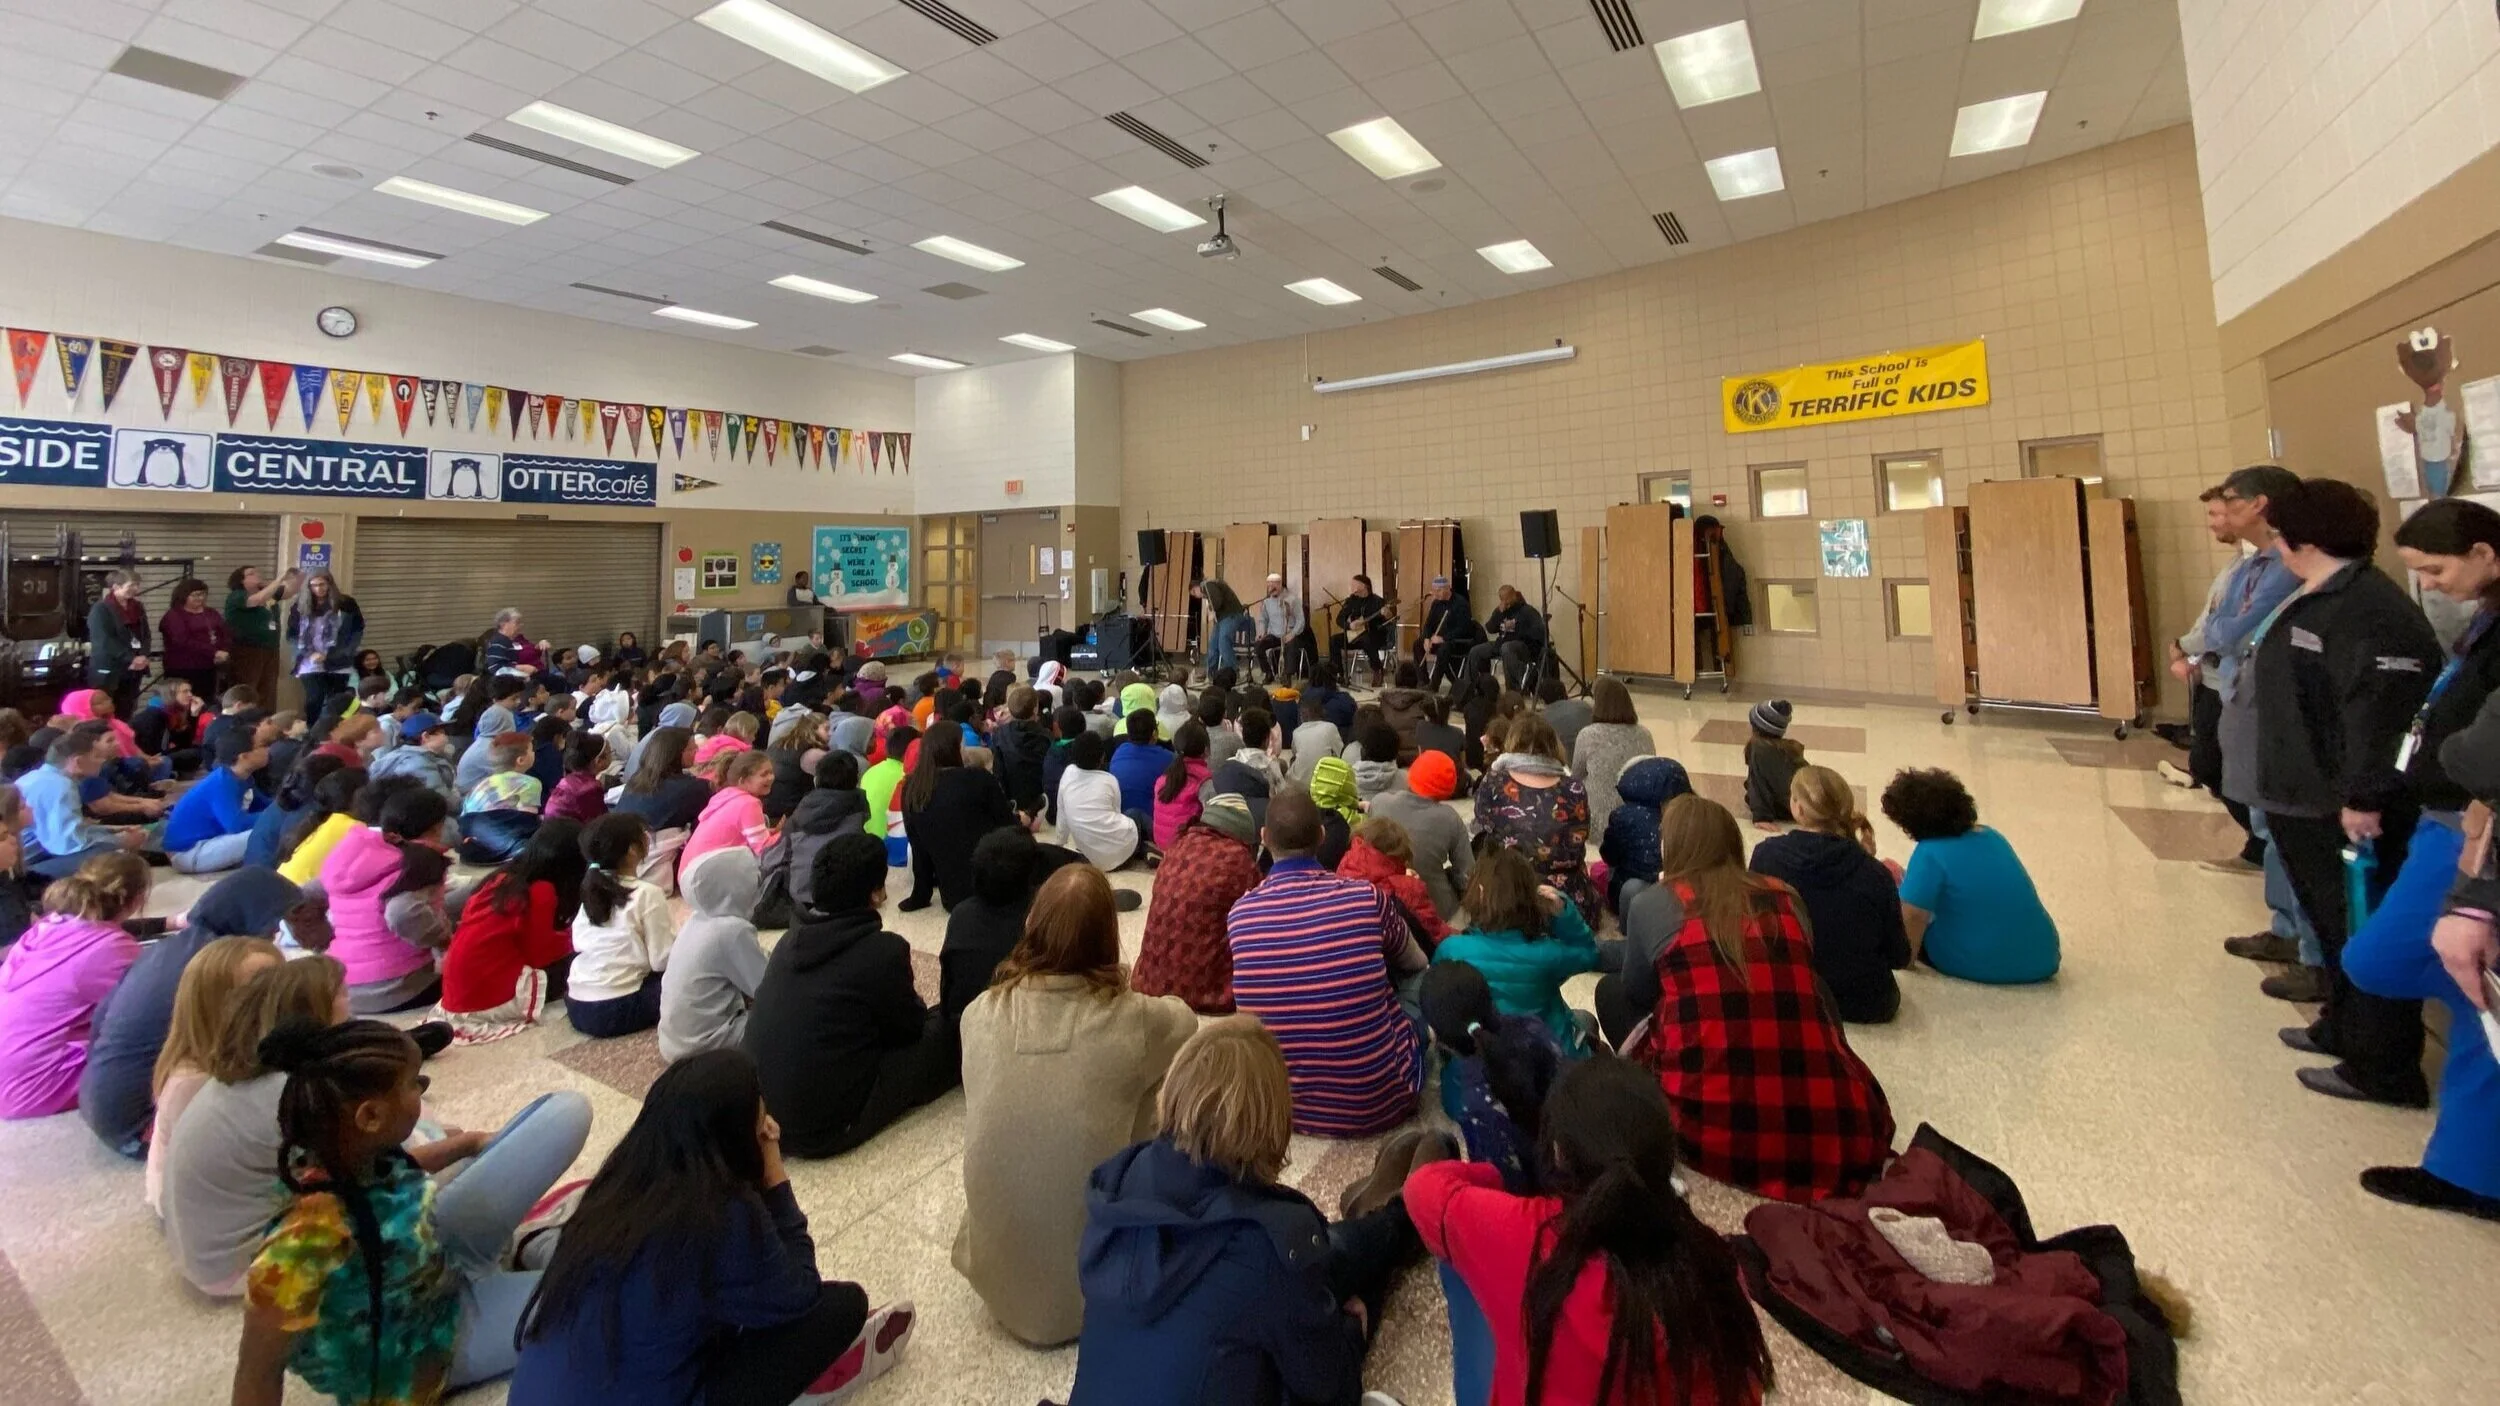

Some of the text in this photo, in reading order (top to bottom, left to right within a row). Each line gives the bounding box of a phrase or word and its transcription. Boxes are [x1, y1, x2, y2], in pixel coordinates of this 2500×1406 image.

[1825, 357, 1928, 382] This School is
[1852, 373, 1902, 391] Full of
[340, 391, 349, 414] LSU
[1788, 377, 1977, 418] TERRIFIC KIDS
[226, 450, 417, 486] CENTRAL
[305, 552, 325, 561] NO
[841, 546, 868, 555] SECRET
[852, 569, 875, 577] GREAT
[851, 578, 880, 587] SCHOOL
